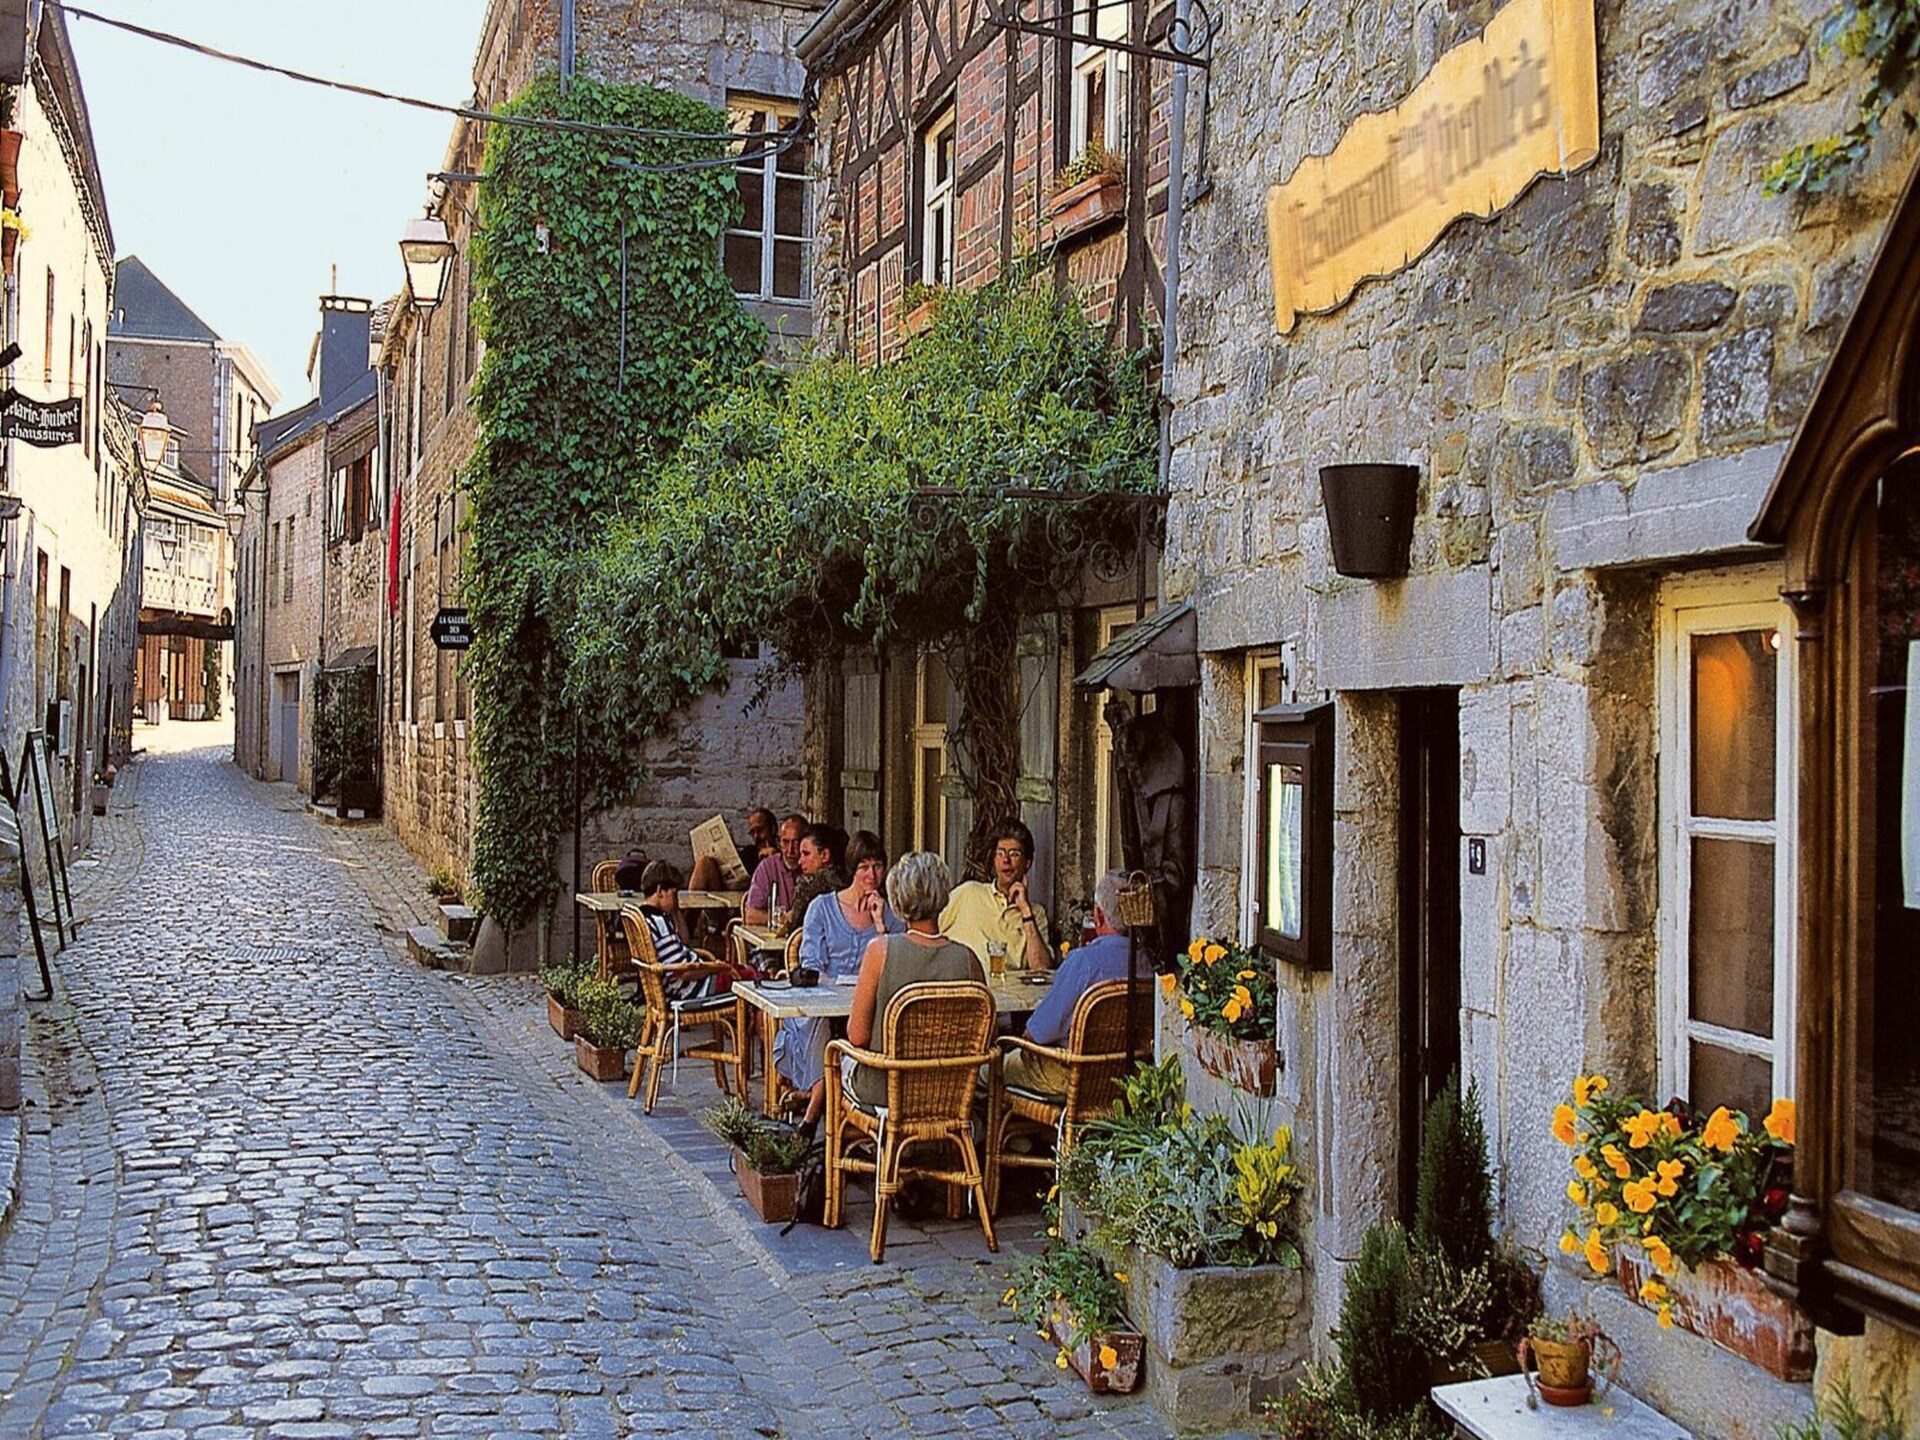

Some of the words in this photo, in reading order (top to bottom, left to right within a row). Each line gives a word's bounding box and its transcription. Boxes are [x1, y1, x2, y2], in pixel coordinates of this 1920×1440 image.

[8, 422, 75, 442] chaussures
[439, 616, 447, 624] LA
[449, 625, 460, 634] DES
